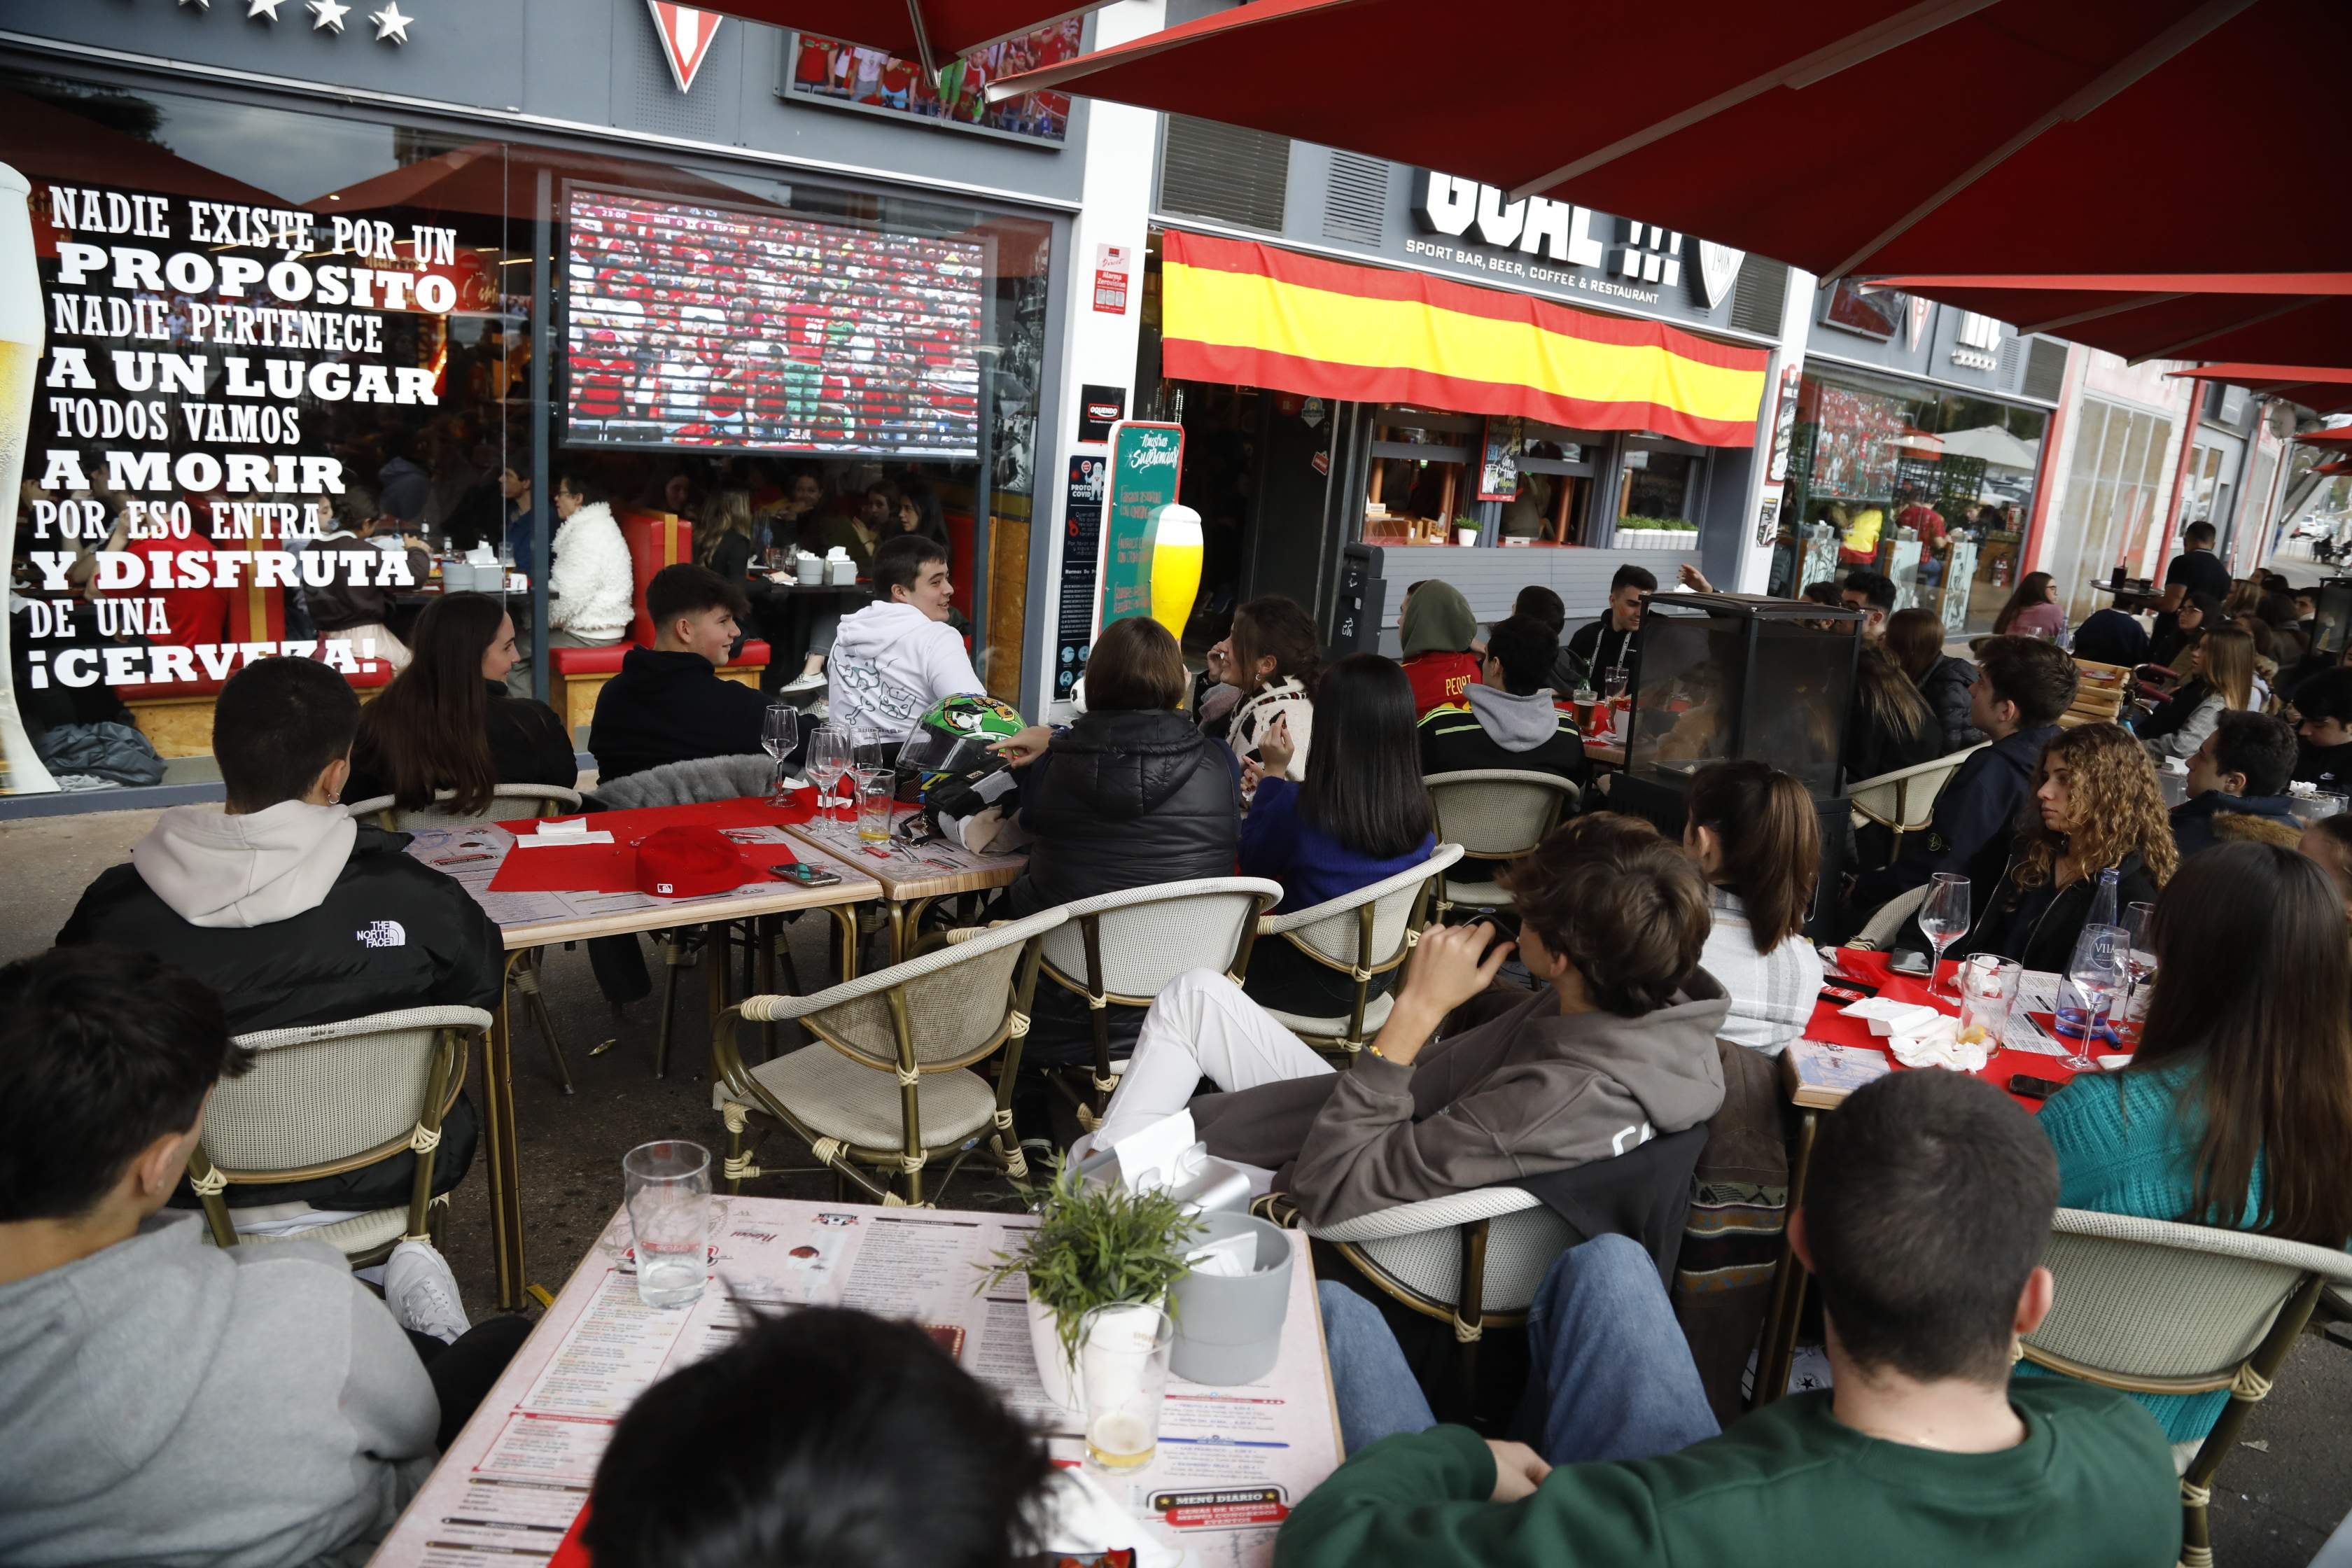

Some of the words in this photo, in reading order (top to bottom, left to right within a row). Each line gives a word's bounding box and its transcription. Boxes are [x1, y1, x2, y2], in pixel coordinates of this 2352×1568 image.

[48, 186, 169, 238] NADIE
[190, 200, 314, 252] EXISTE
[332, 216, 397, 260] POR
[412, 226, 456, 265] UN
[602, 210, 627, 219] 23:00
[56, 241, 456, 313] PROPÓSITO
[1406, 239, 1453, 260] SPORT
[1455, 251, 1485, 270] BAR,
[1489, 258, 1525, 278] BEER,
[1530, 267, 1575, 286] COFFEE
[1578, 277, 1587, 289] &
[1590, 279, 1659, 304] RESTAURANT
[52, 294, 170, 340] NADIE
[189, 302, 383, 353] PERTENECE
[46, 348, 95, 388] A
[113, 351, 208, 394] UN
[225, 356, 438, 405] LUGAR
[50, 398, 168, 440] TODOS
[182, 404, 300, 444] VAMOS
[1090, 407, 1118, 417] OQUENDO
[41, 449, 90, 489] A
[106, 451, 346, 493] MORIR
[33, 500, 108, 539] POR
[127, 500, 192, 540] ESO
[211, 502, 321, 539] ENTRA
[31, 551, 76, 590] Y
[96, 550, 414, 589] DISFRUTA
[29, 599, 75, 638] DE
[94, 598, 171, 636] UNA
[357, 929, 389, 941] NORTH
[367, 938, 390, 948] FACE
[370, 920, 390, 930] THE
[1216, 1492, 1263, 1503] DIARIO
